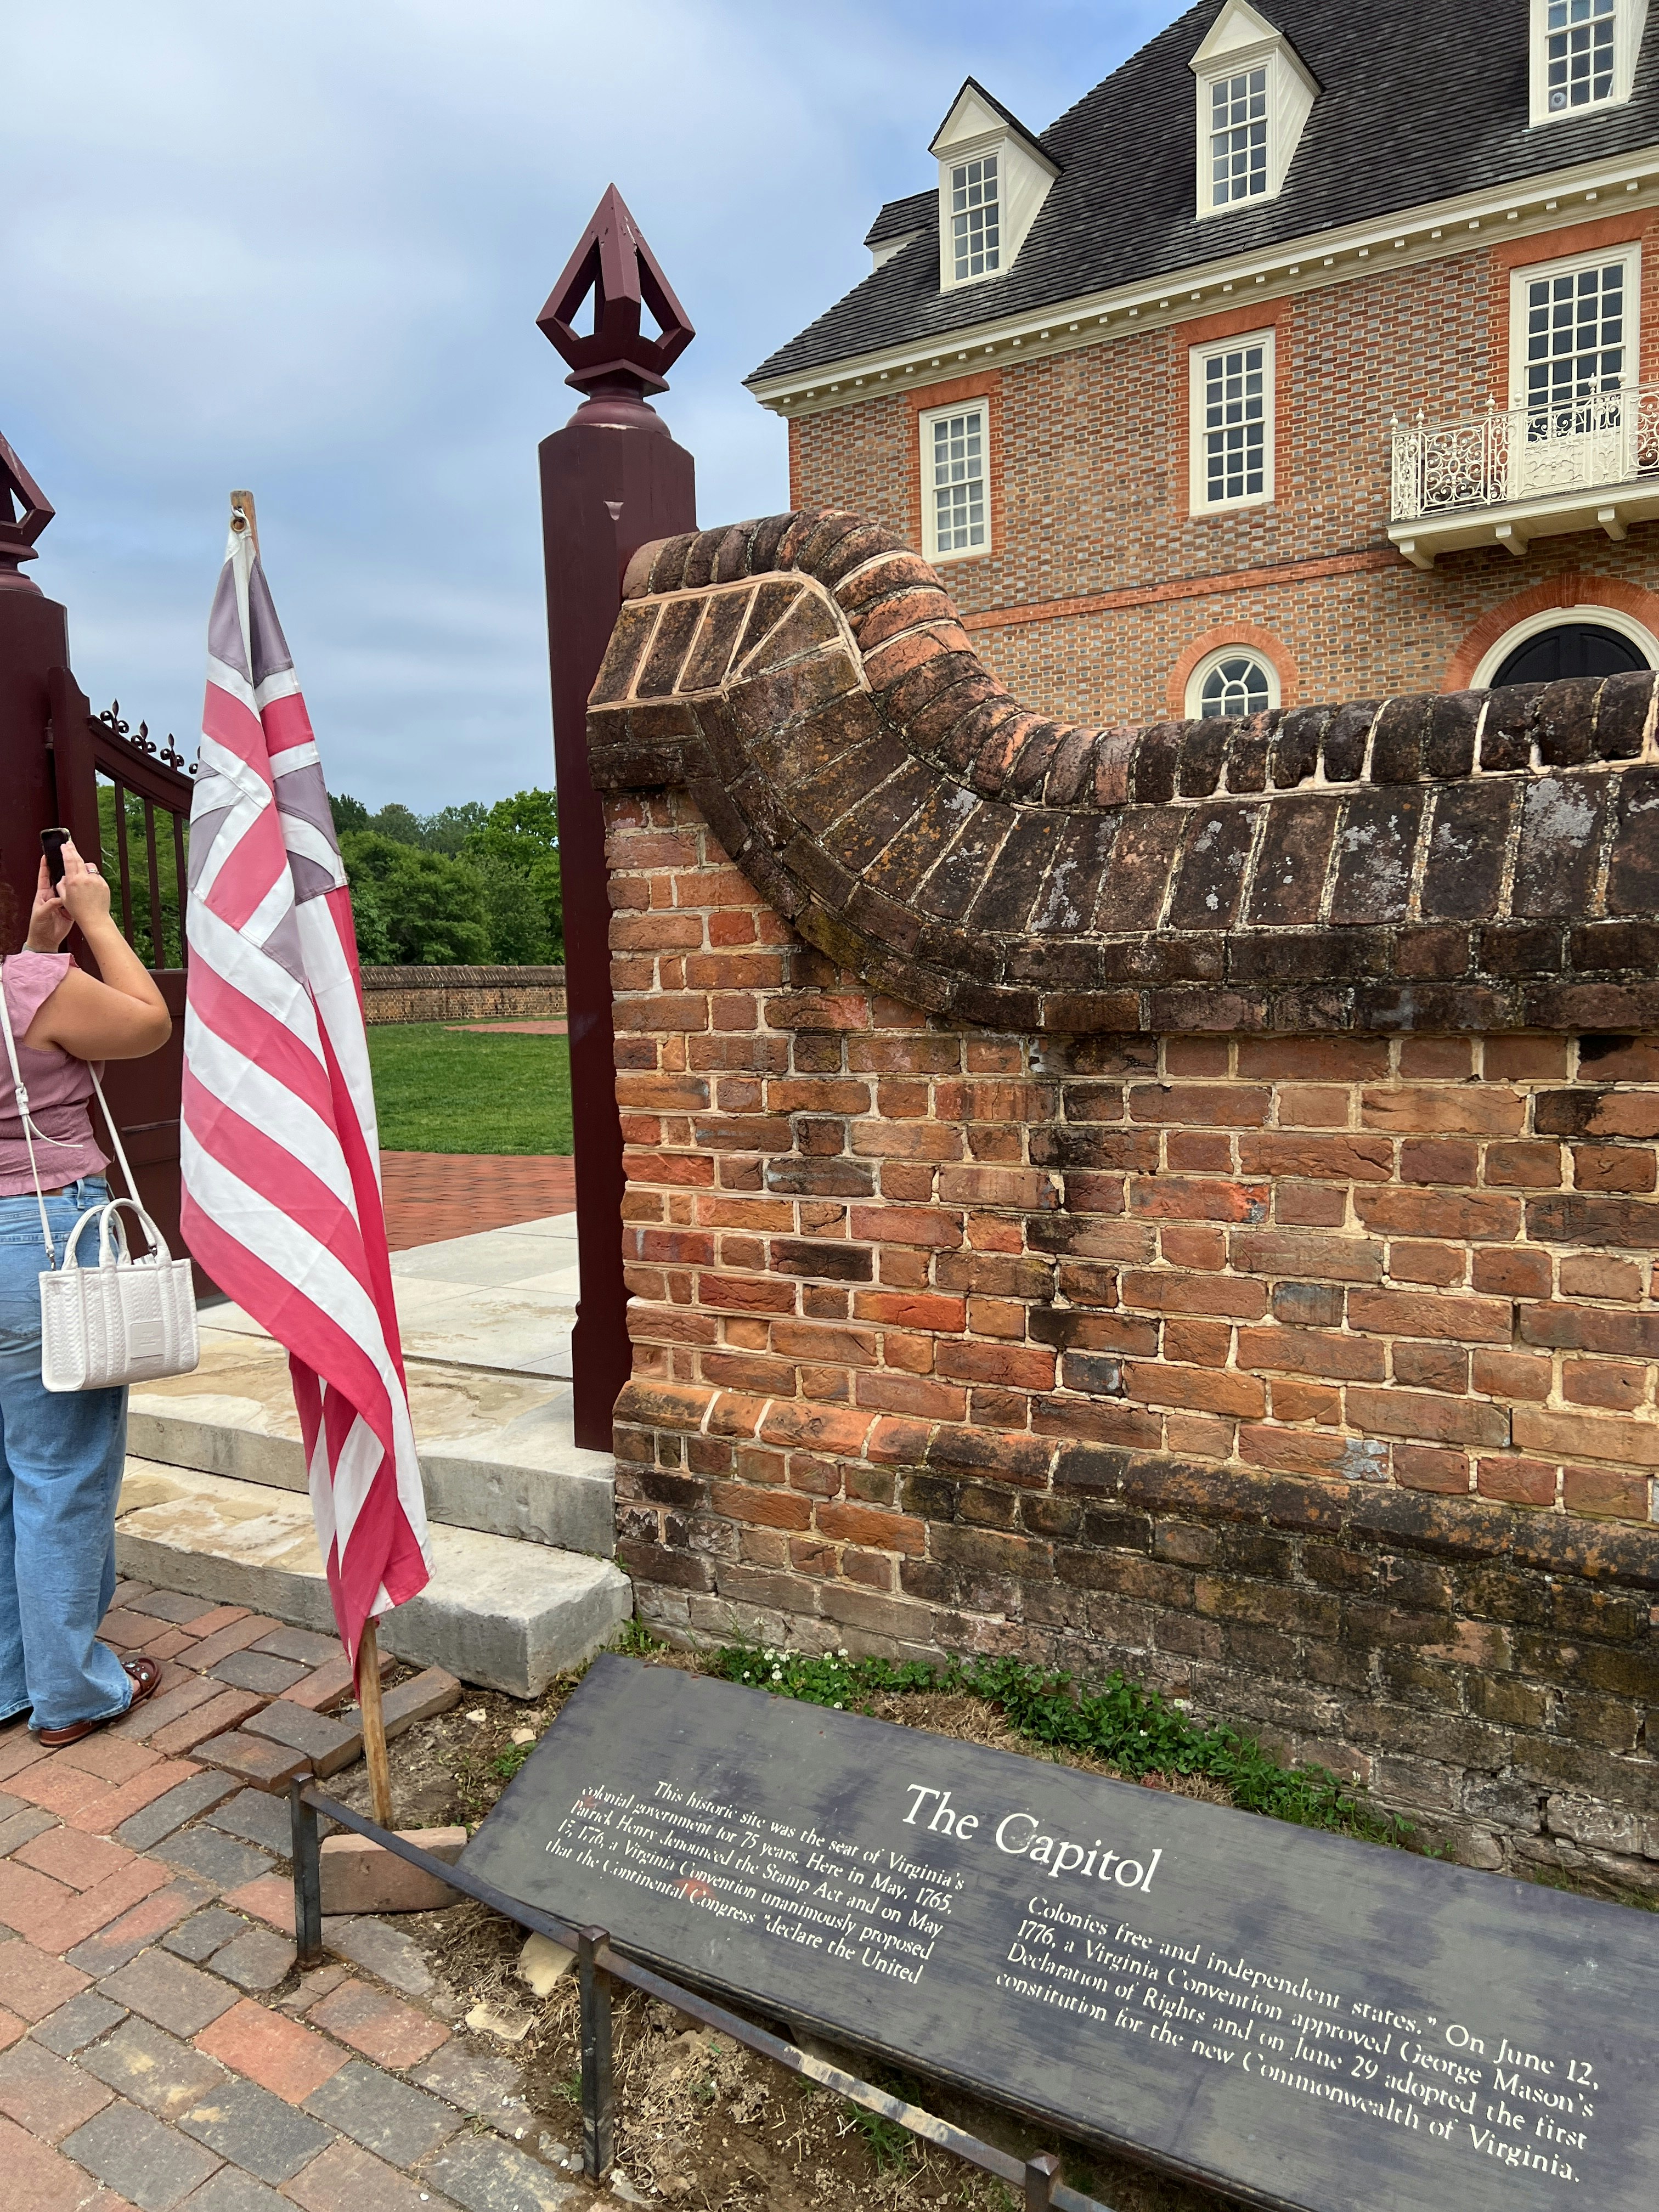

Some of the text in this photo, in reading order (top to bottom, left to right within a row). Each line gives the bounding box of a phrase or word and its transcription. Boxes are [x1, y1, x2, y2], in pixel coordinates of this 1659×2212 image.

[570, 1799, 944, 1939] Patrick Henry denounced the Stamp Act and on May
[577, 1825, 605, 1849] 1776,
[608, 1842, 618, 1851] a
[624, 1839, 675, 1871] Virginia
[679, 1860, 757, 1899] Convention
[761, 1892, 857, 1937] unanimously
[859, 1926, 935, 1960] proposed
[582, 1785, 635, 1809] colonial
[631, 1804, 712, 1835] government
[715, 1826, 737, 1843] for
[740, 1831, 760, 1849] 75
[805, 1852, 843, 1877] Here
[847, 1866, 865, 1884] in
[654, 1781, 964, 1890] This historic site was the seat of Virginia's
[902, 1784, 1163, 1893] The Capitol
[545, 1838, 573, 1858] that
[576, 1849, 600, 1868] the
[602, 1859, 689, 1899] Continental
[689, 1888, 756, 1924] Congress
[827, 1937, 855, 1960] the
[862, 1946, 924, 1984] United
[1007, 1942, 1588, 2150] Declaration of Rights and on June 29 adopted the first
[1017, 1920, 1594, 2117] 1776, a Virginia Convention approved George Mason's
[1028, 1897, 1108, 1936] Colonies
[1114, 1922, 1153, 1949] free
[1159, 1943, 1200, 1965] and
[1206, 1952, 1340, 2008] independent
[1446, 2024, 1485, 2055] On
[1493, 2039, 1555, 2074] June
[1566, 2059, 1599, 2090] 12,
[996, 1973, 1579, 2182] constitution for the new Commonwealth of Virginia.
